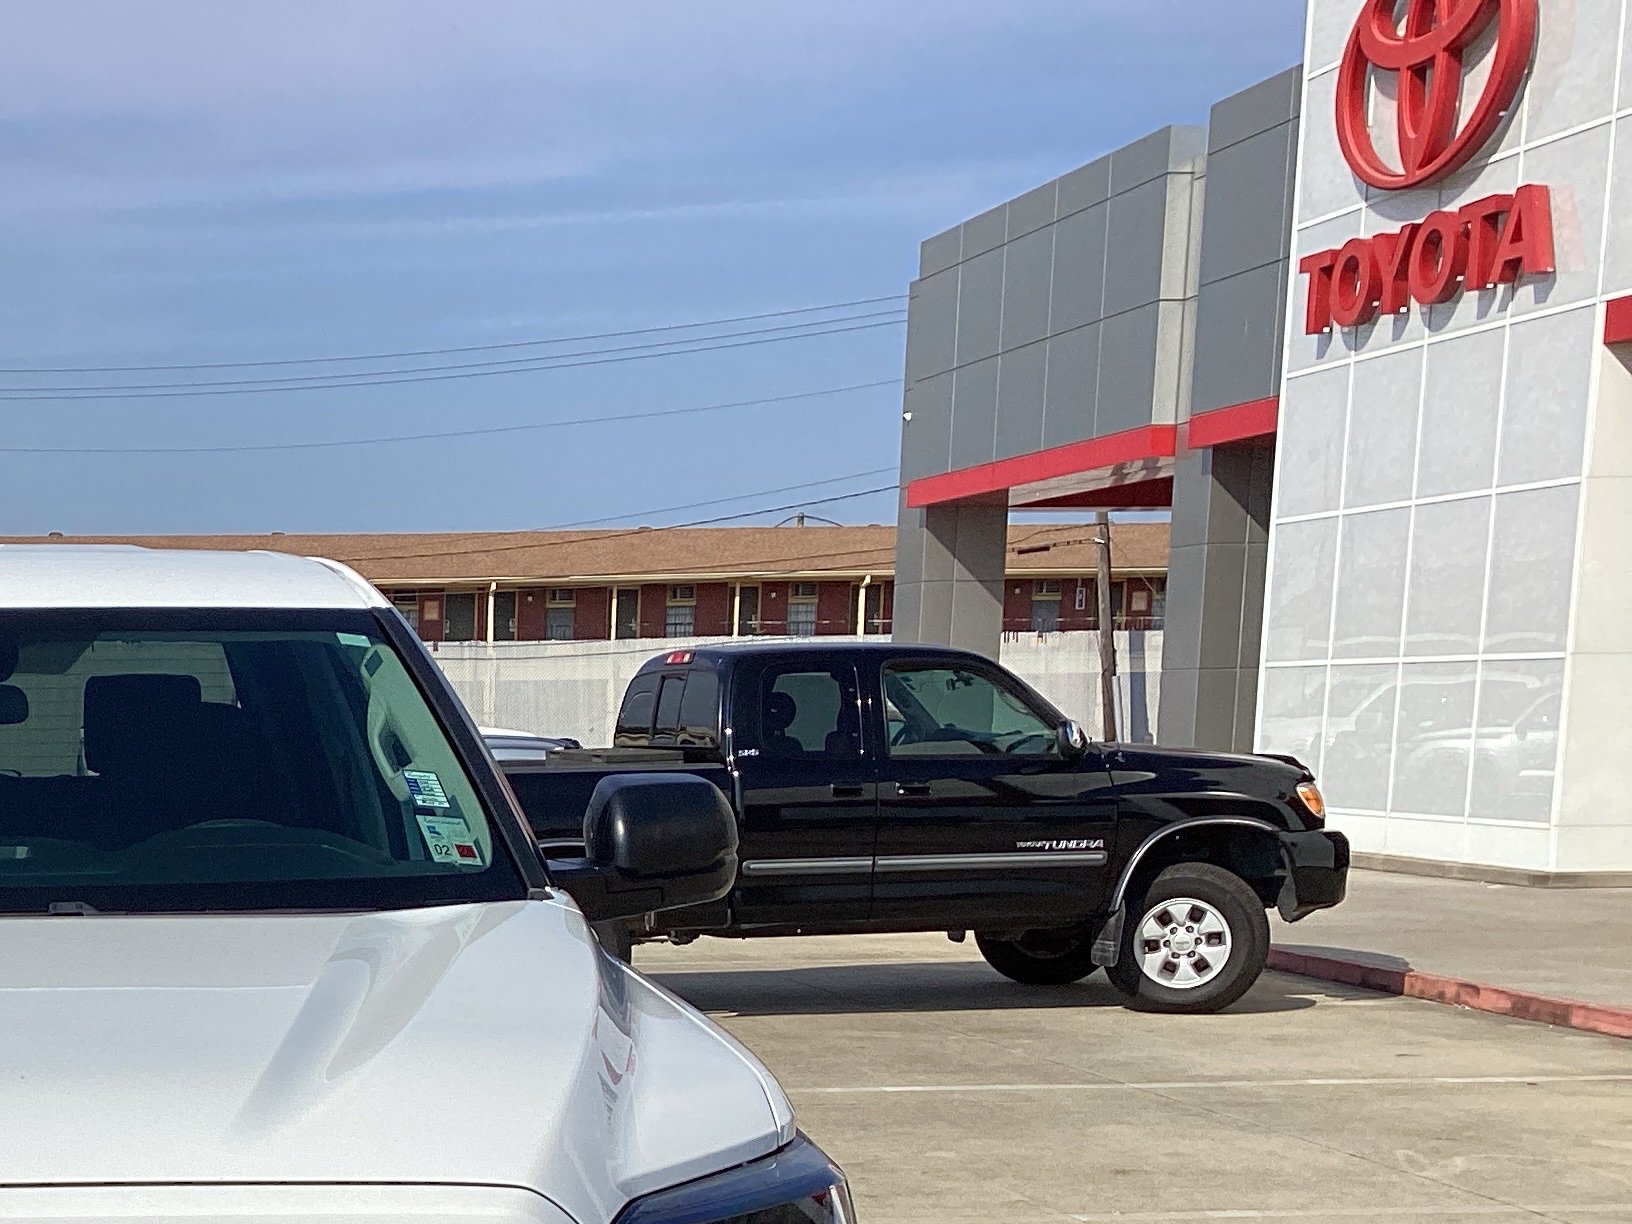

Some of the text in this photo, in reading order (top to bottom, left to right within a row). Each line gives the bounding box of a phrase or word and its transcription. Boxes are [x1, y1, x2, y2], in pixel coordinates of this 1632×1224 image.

[1299, 184, 1556, 336] TOYOTA
[433, 843, 453, 856] 02
[1042, 839, 1104, 850] TUNDRA
